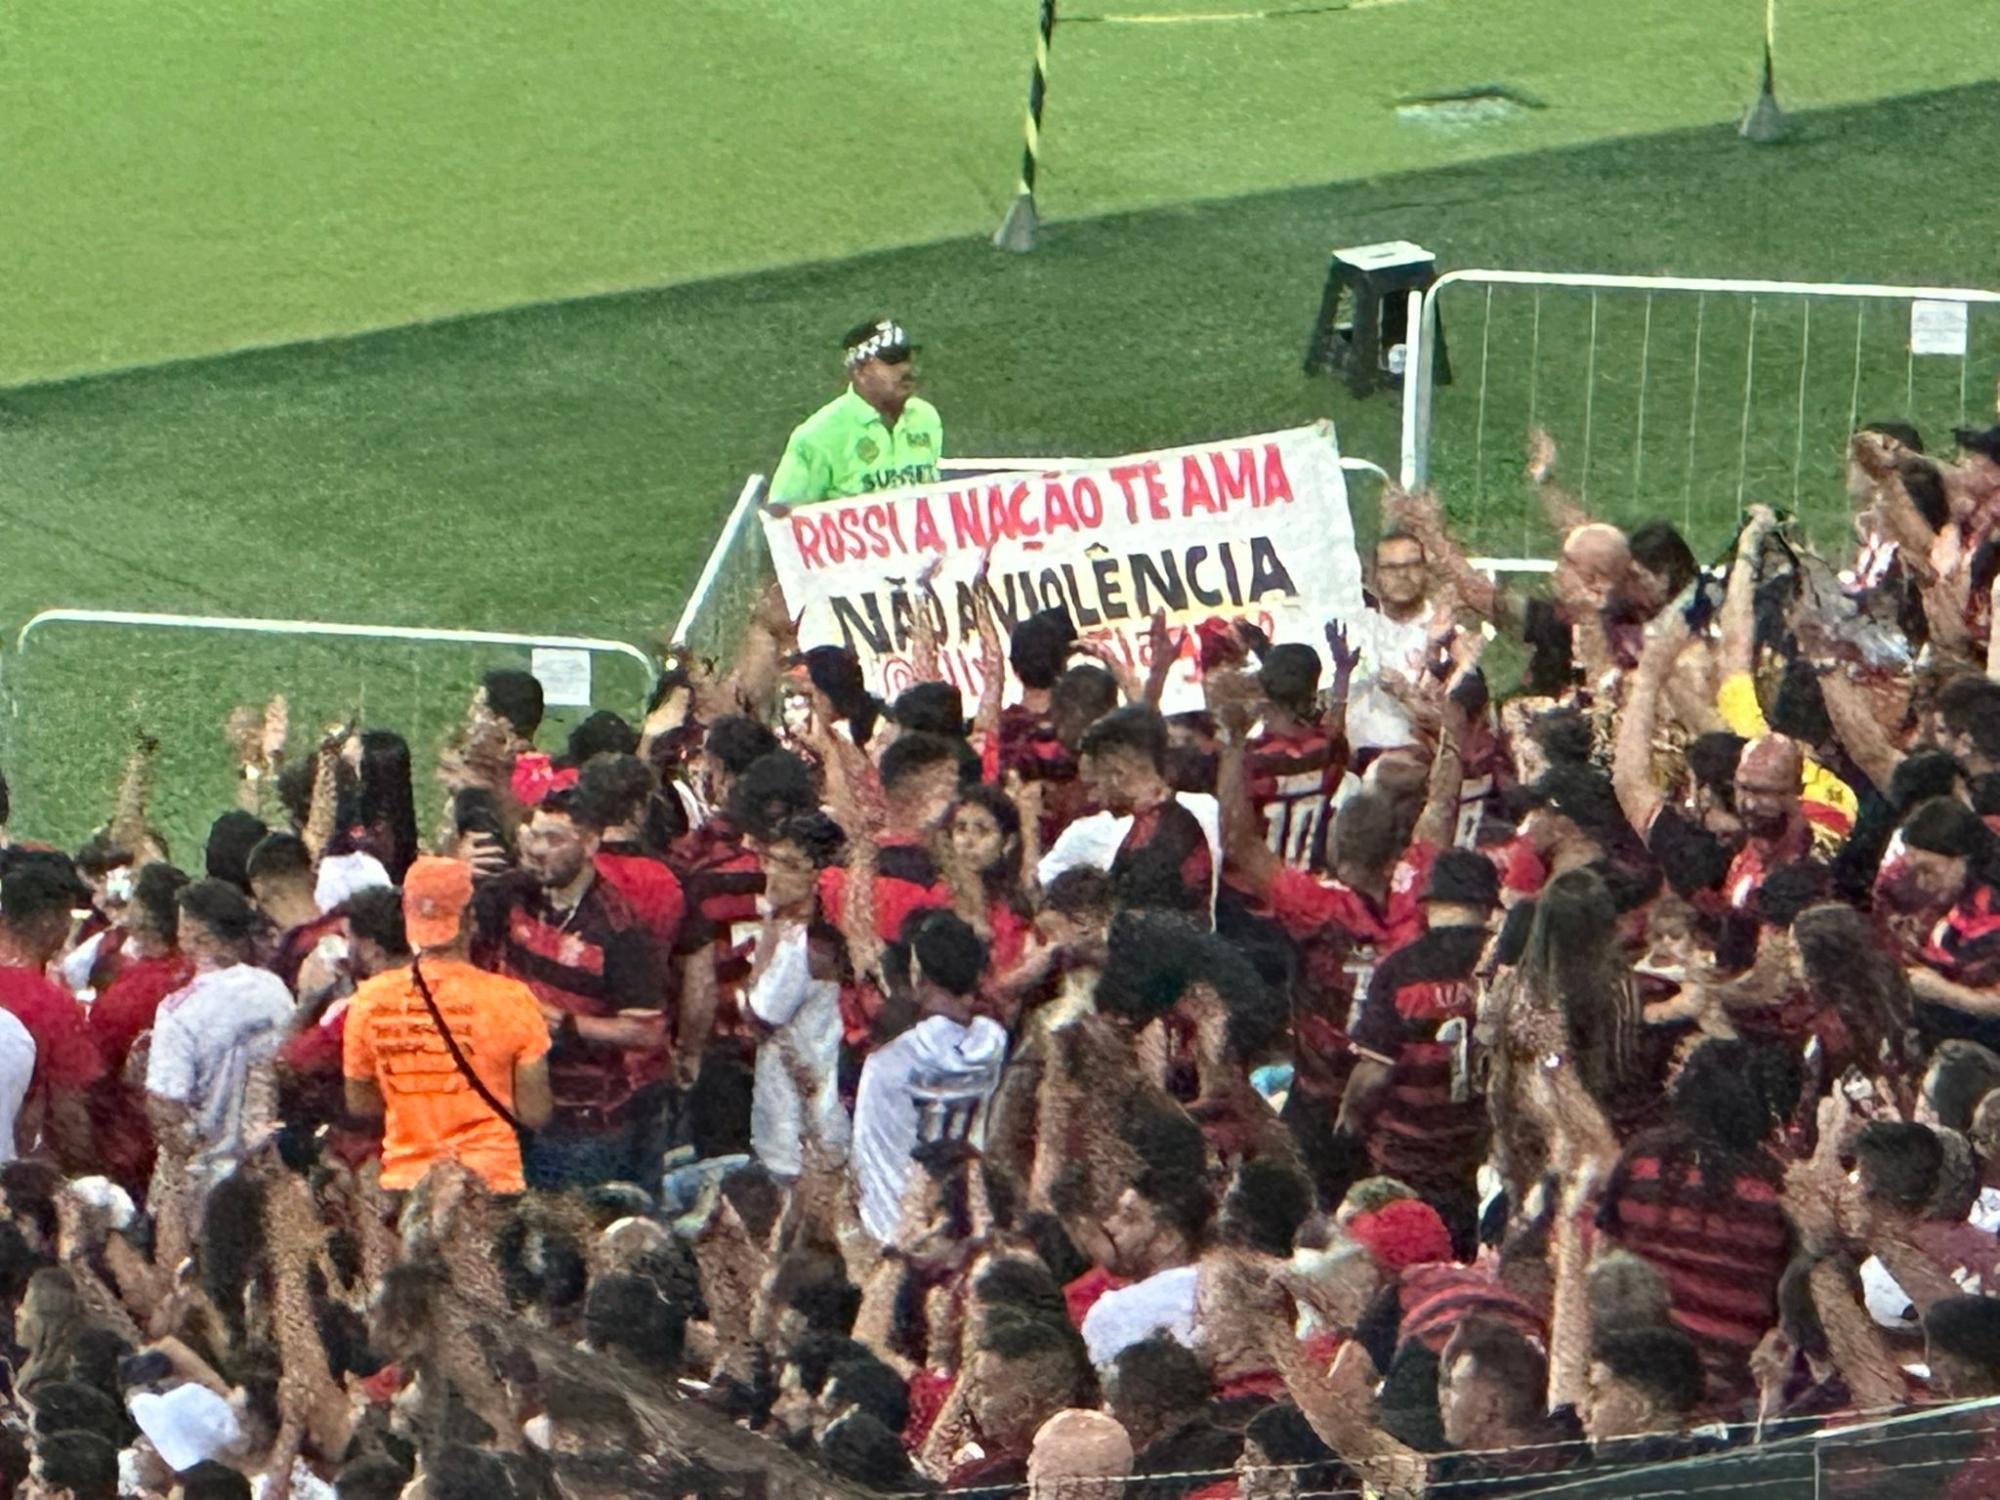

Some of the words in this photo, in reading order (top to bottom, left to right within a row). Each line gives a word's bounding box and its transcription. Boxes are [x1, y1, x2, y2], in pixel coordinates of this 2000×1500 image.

[791, 502, 909, 569] ROSSI
[914, 497, 947, 554] A
[947, 471, 1103, 550] NAÇÃO
[1109, 461, 1171, 524] TE
[1182, 443, 1294, 517] AMA
[984, 537, 1298, 633] VIOLÊNCIA
